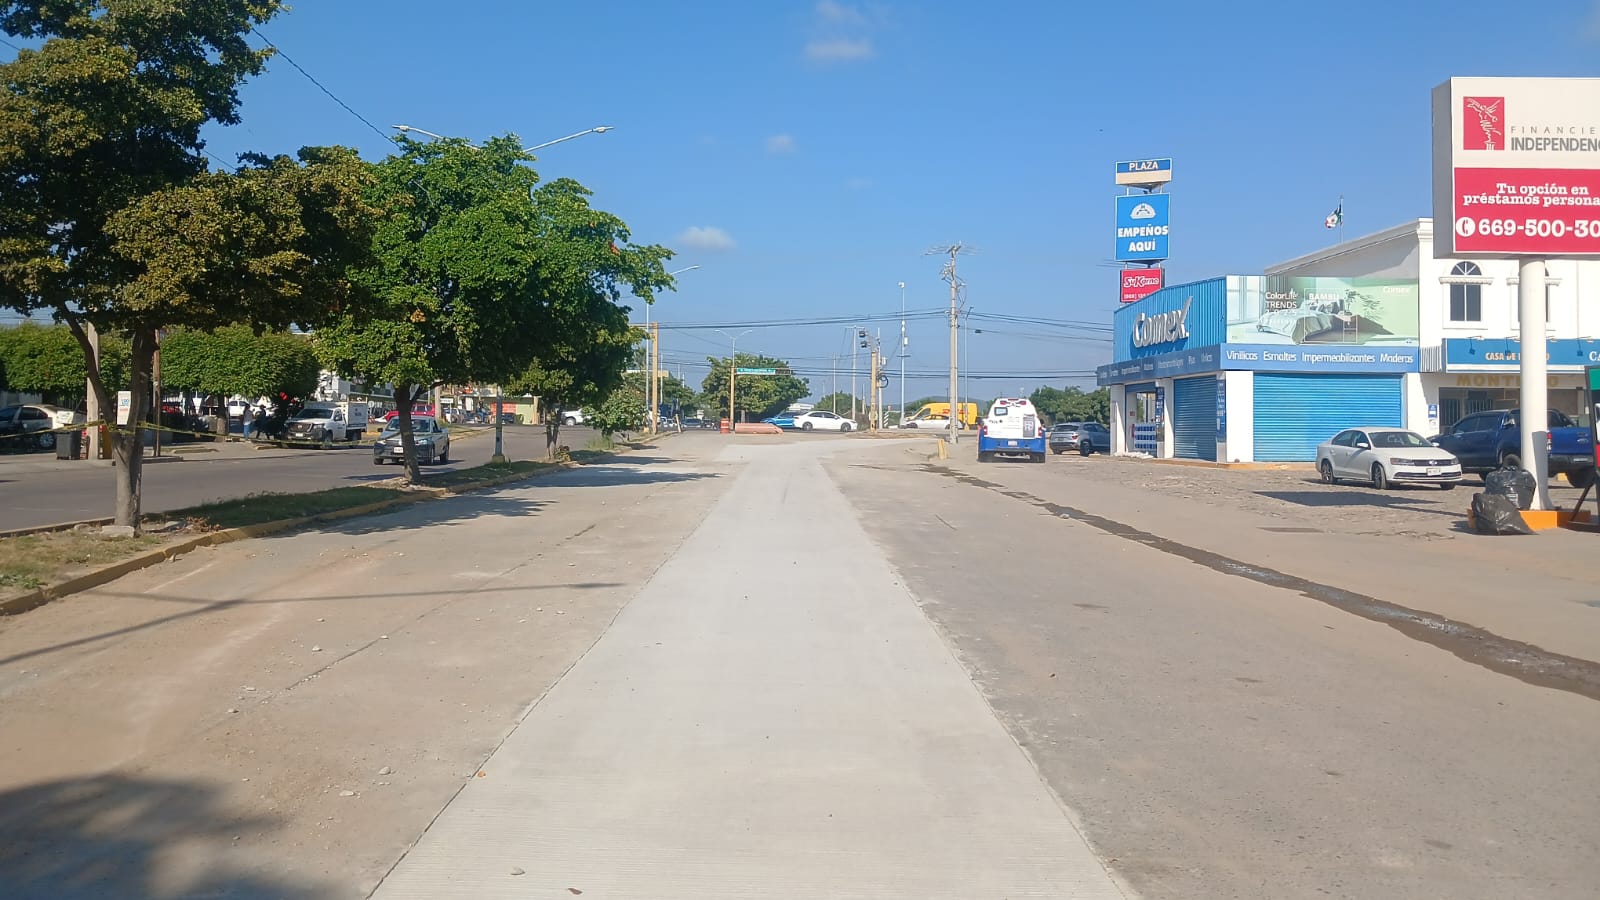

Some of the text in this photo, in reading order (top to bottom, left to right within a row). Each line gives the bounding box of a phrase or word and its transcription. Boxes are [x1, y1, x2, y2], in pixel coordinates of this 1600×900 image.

[1511, 126, 1595, 135] FINANCIE
[1128, 161, 1159, 171] PLAZA
[1496, 183, 1589, 198] Tu opción en
[1463, 193, 1540, 206] préstamos
[1117, 223, 1169, 238] EMPEÑOS
[1479, 219, 1600, 238] 669-500-30
[1123, 276, 1160, 288] SuKarne
[1265, 301, 1297, 309] TRENDS
[1133, 296, 1193, 348] Comex
[1263, 350, 1297, 361] Esmaltes
[1302, 352, 1376, 364] Impermeabilizantes
[1380, 353, 1414, 363] Maderas
[1485, 352, 1505, 361] CASA
[1506, 352, 1516, 361] DE
